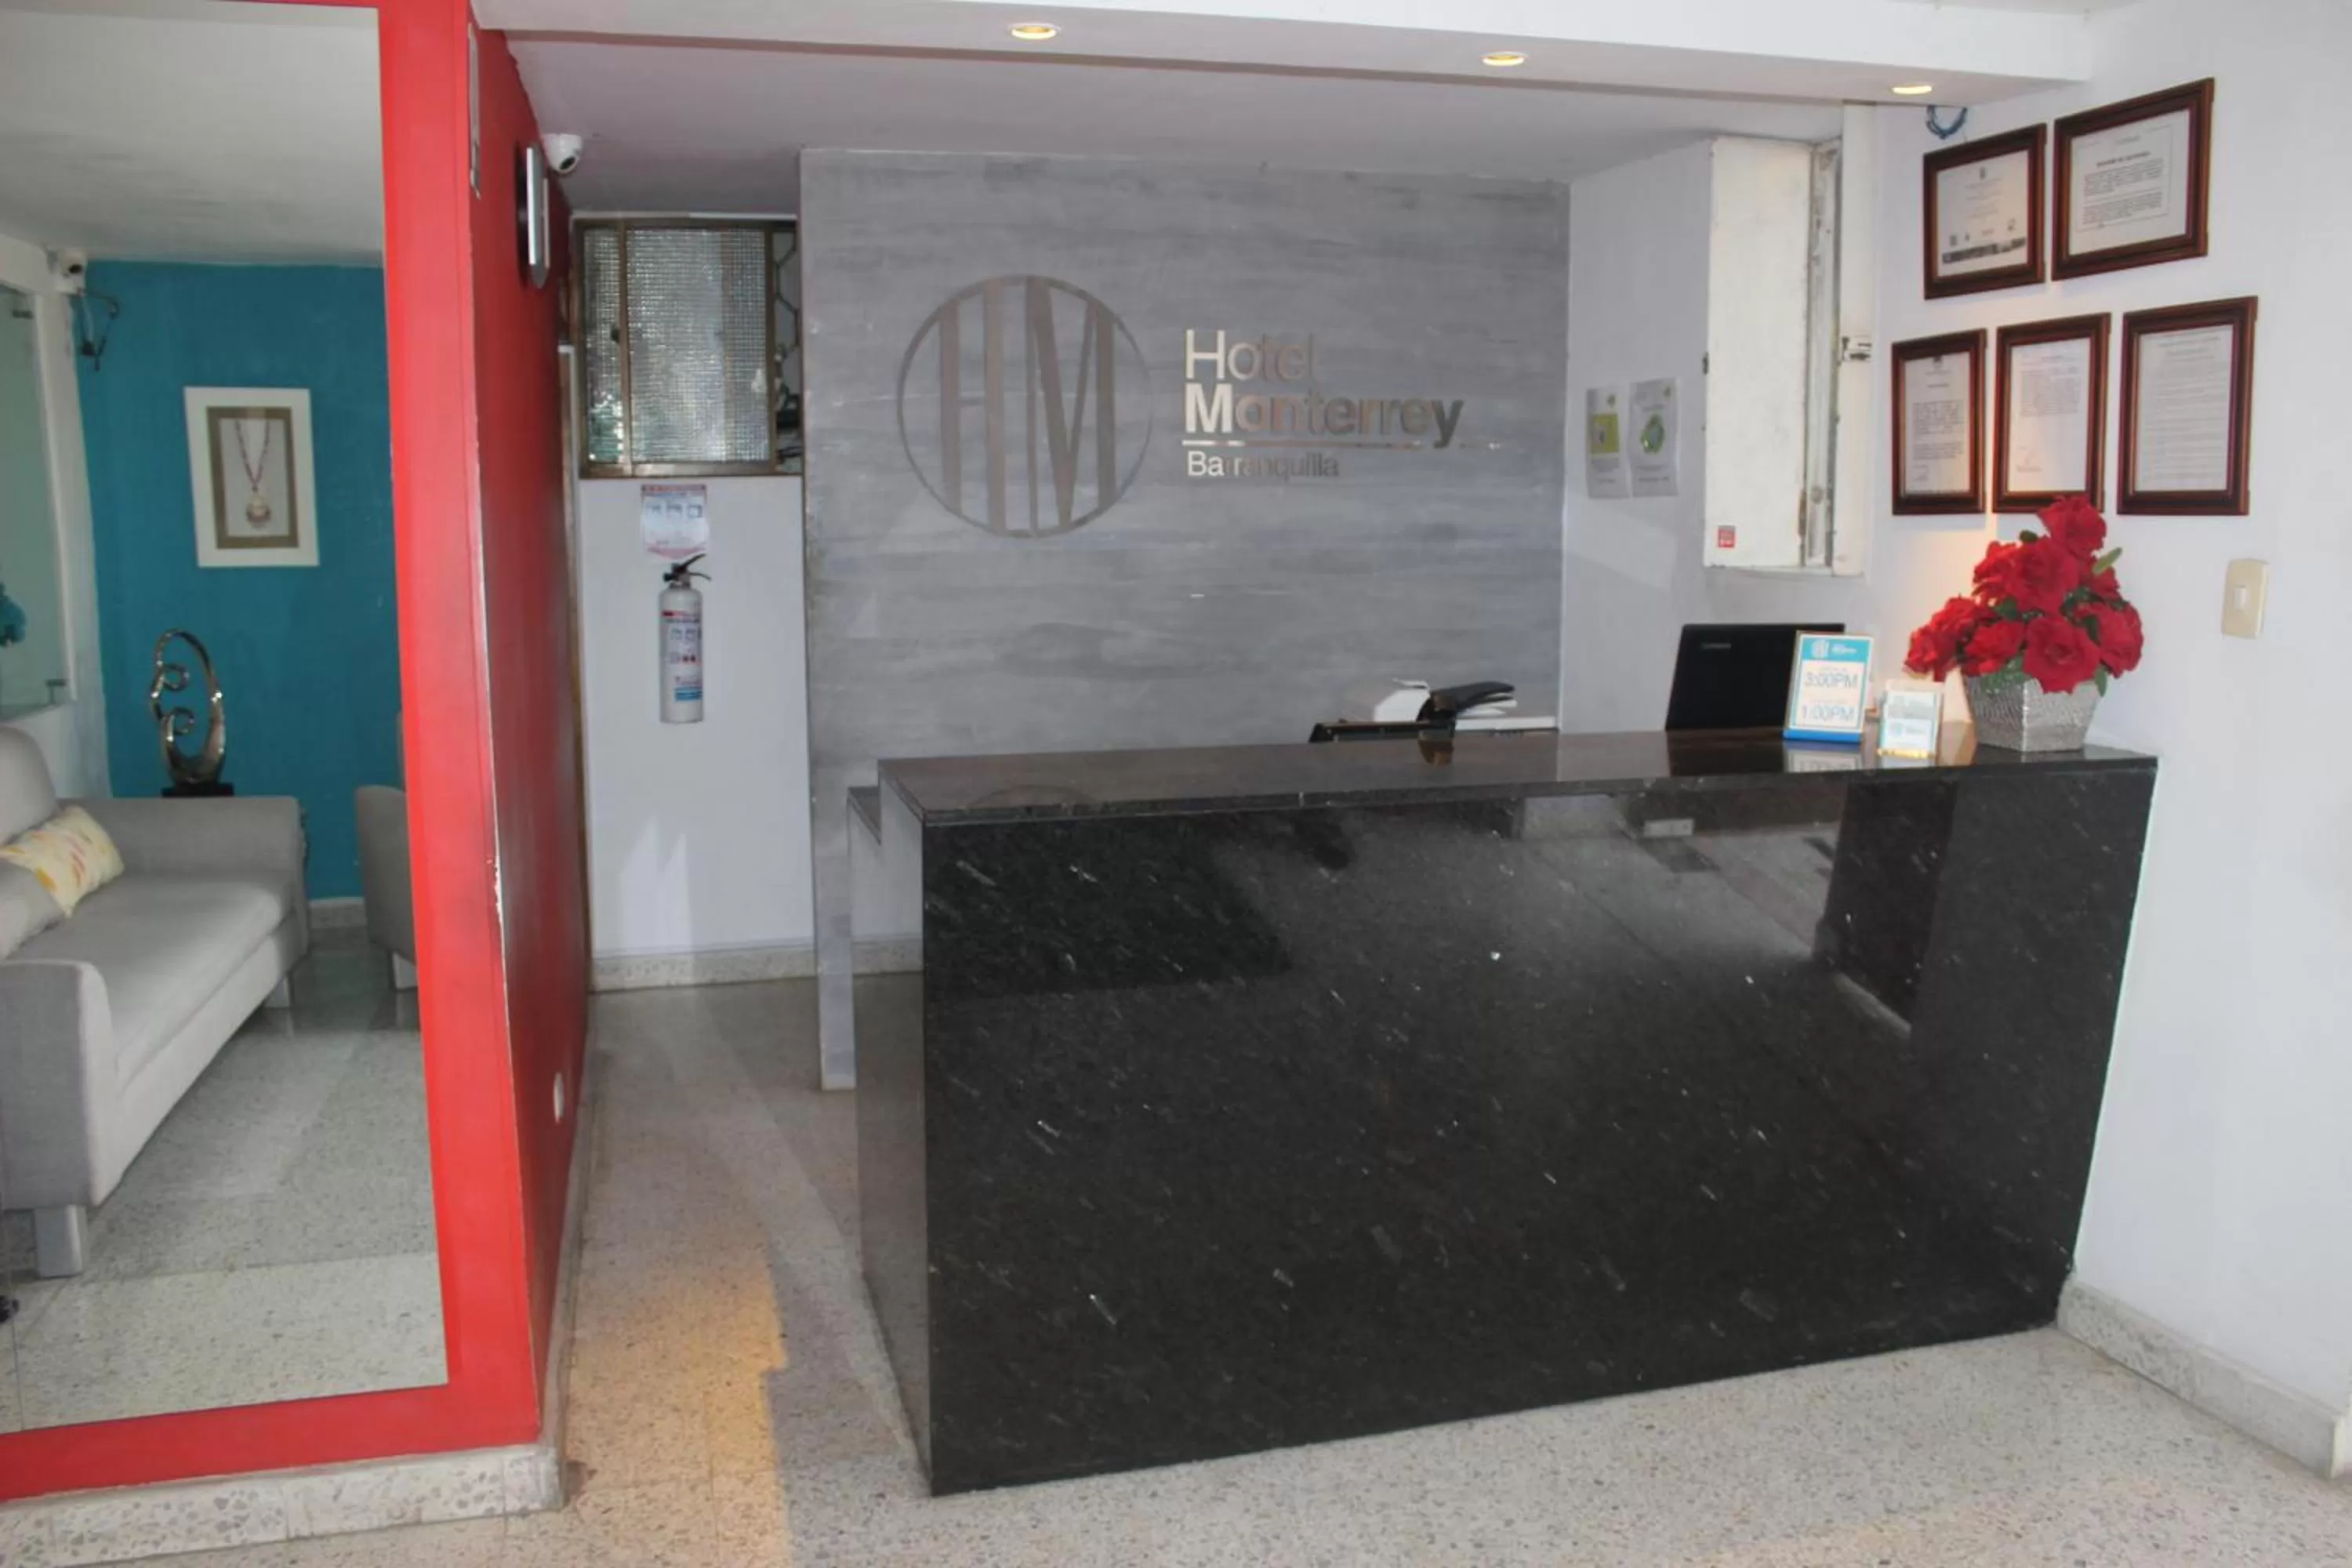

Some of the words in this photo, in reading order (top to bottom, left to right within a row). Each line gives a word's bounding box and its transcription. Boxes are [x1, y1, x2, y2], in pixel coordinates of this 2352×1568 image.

[1185, 328, 1316, 381] Hotel
[937, 276, 1116, 532] HM
[1184, 382, 1465, 450] Monterrey
[1187, 449, 1340, 482] Barranquilla
